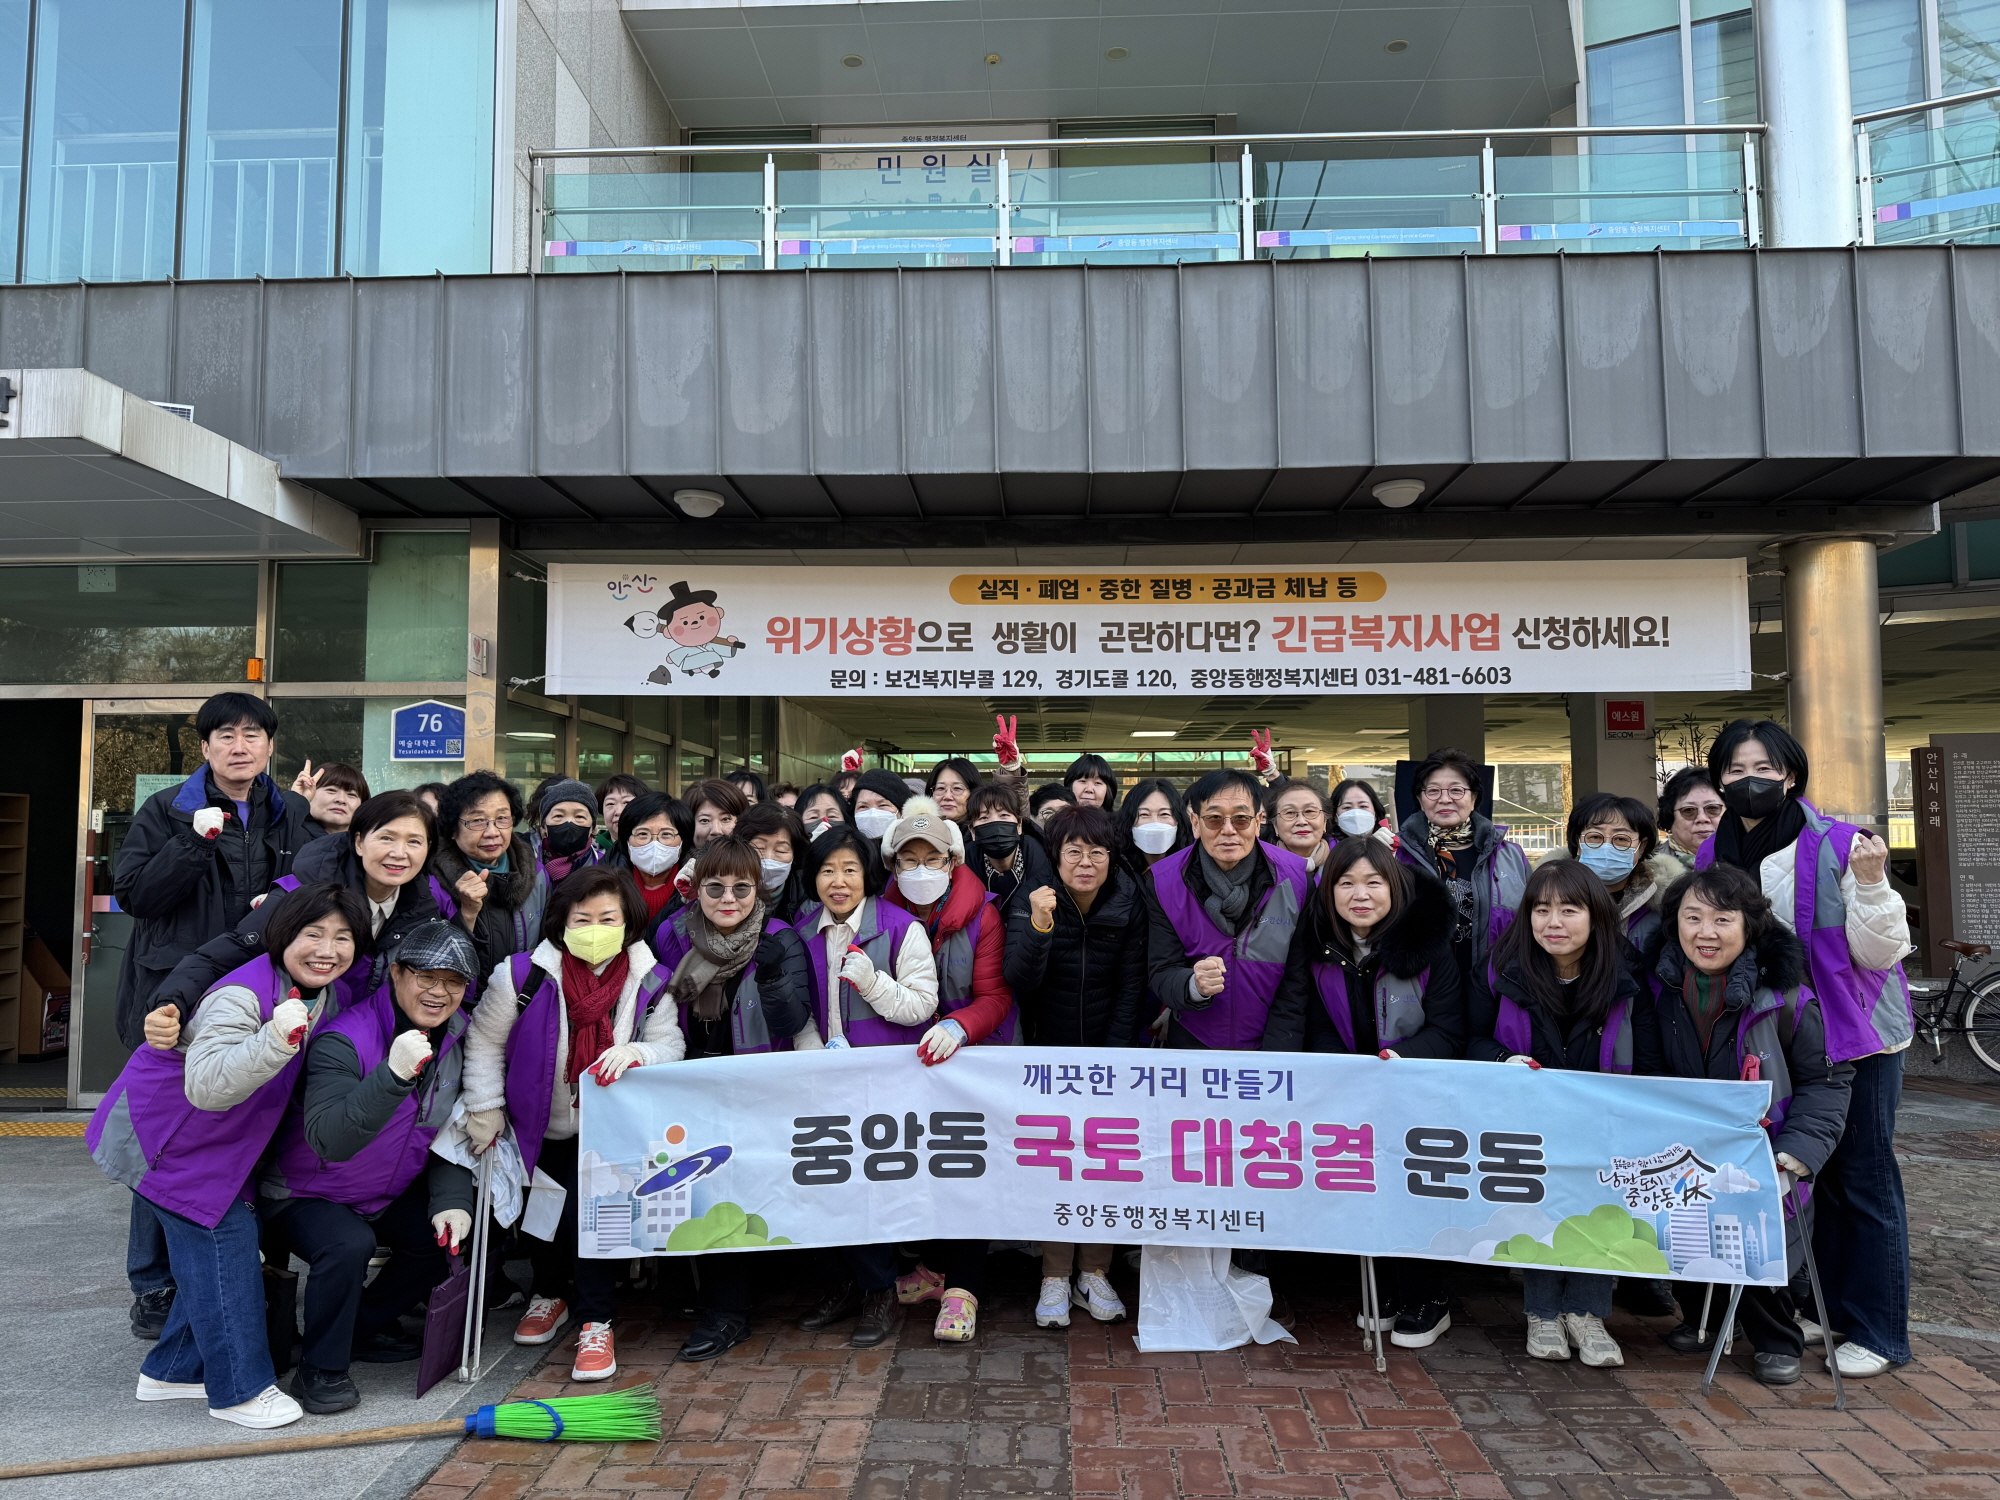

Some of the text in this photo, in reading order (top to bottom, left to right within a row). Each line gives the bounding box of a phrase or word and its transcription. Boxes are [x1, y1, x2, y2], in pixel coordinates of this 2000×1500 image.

[877, 152, 992, 184] 민원실
[977, 578, 1020, 600] 실직
[1038, 578, 1080, 600] 폐업
[1098, 578, 1141, 600] 중한
[1149, 578, 1192, 600] 질병
[1212, 578, 1277, 599] 공과금
[1284, 576, 1328, 598] 체납
[1336, 576, 1358, 599] 등
[765, 613, 1670, 656] 위기상황으로 생활이 곤란하다면? 긴급복지사업 신청하세요!
[830, 670, 866, 690] 문의
[884, 668, 995, 688] 보건복지부콜
[1002, 670, 1044, 690] 129,
[1055, 668, 1129, 689] 경기도콜
[1136, 669, 1176, 690] 120,
[1190, 667, 1358, 688] 중앙동행정복지센터
[1365, 666, 1512, 686] 031-481-6603
[418, 713, 443, 733] 76
[1612, 710, 1639, 722] 에스원
[398, 739, 436, 748] 예술대학로
[1926, 752, 1940, 827] 안산시 유래
[1022, 1064, 1294, 1102] 깨끗한 거리 만들기
[790, 1111, 1547, 1204] 중앙동 국토 대청결 운동
[1626, 1187, 1676, 1211] 중앙동
[1052, 1202, 1266, 1233] 중앙동행정복지센터
